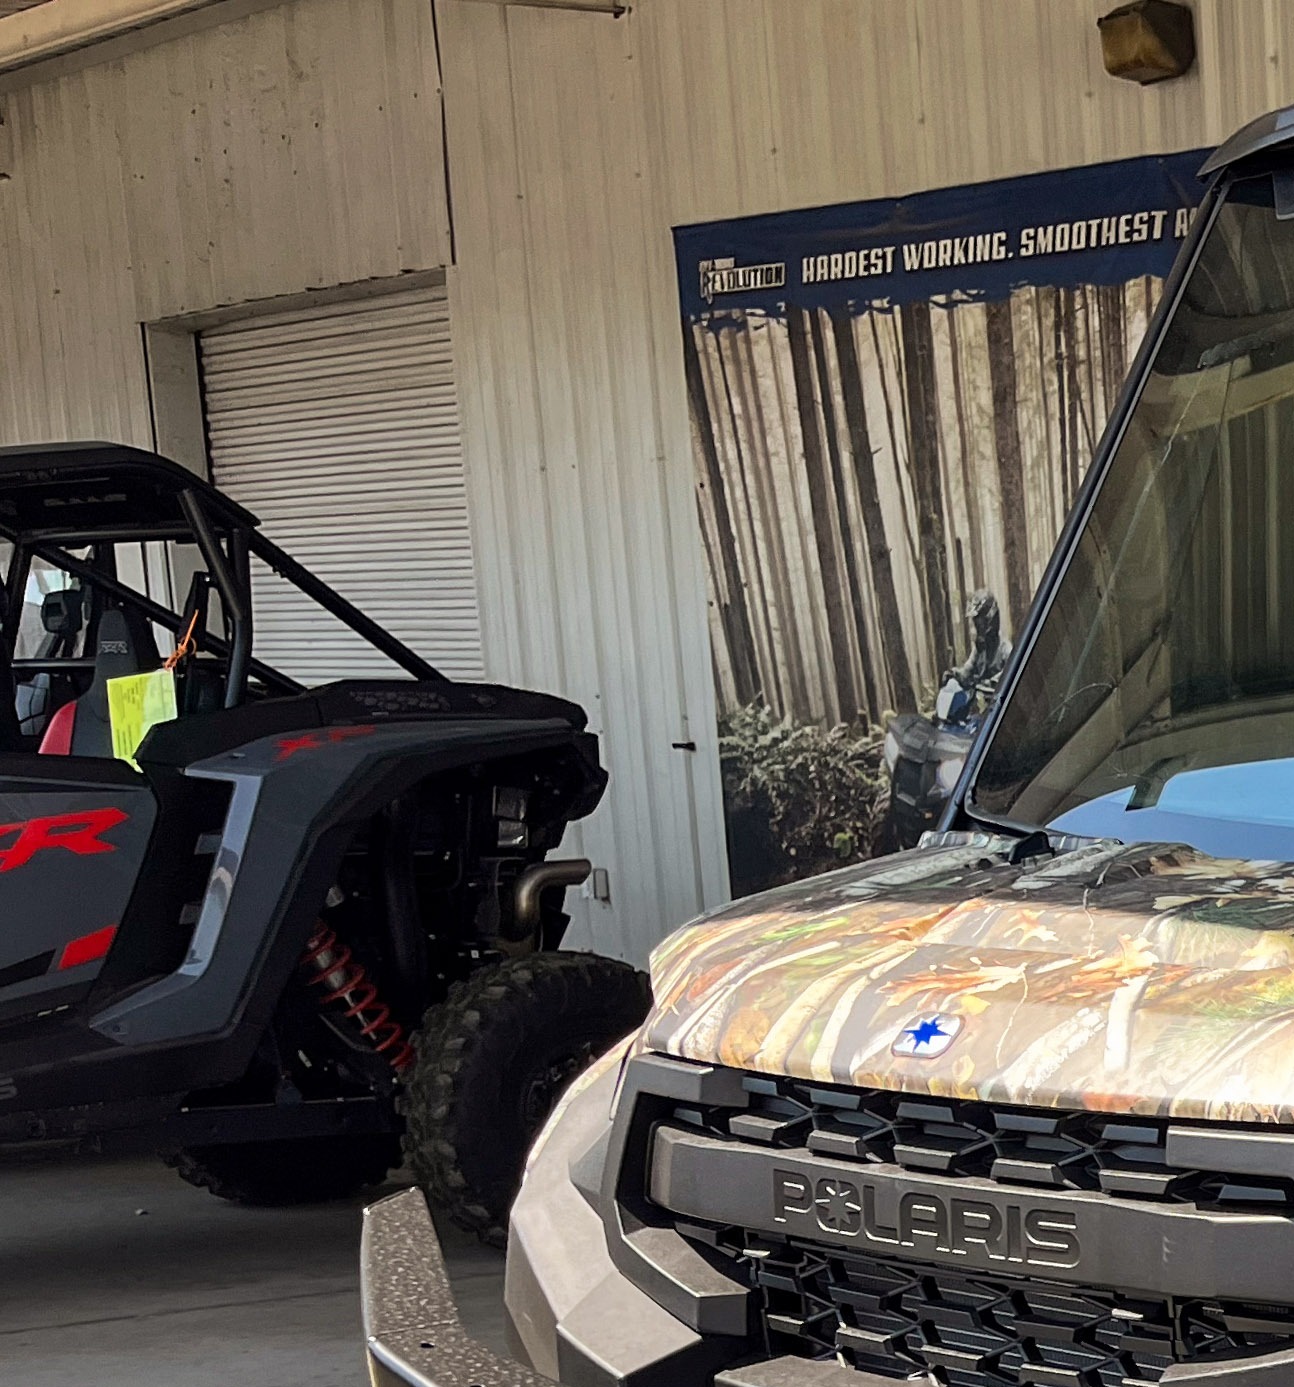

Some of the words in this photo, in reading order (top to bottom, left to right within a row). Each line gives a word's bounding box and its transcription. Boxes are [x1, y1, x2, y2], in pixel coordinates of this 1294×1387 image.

[802, 246, 896, 284] HARDEST
[902, 231, 1014, 272] WORKING.
[1019, 210, 1168, 258] SMOOTHEST
[773, 1168, 1081, 1268] POLARIS
